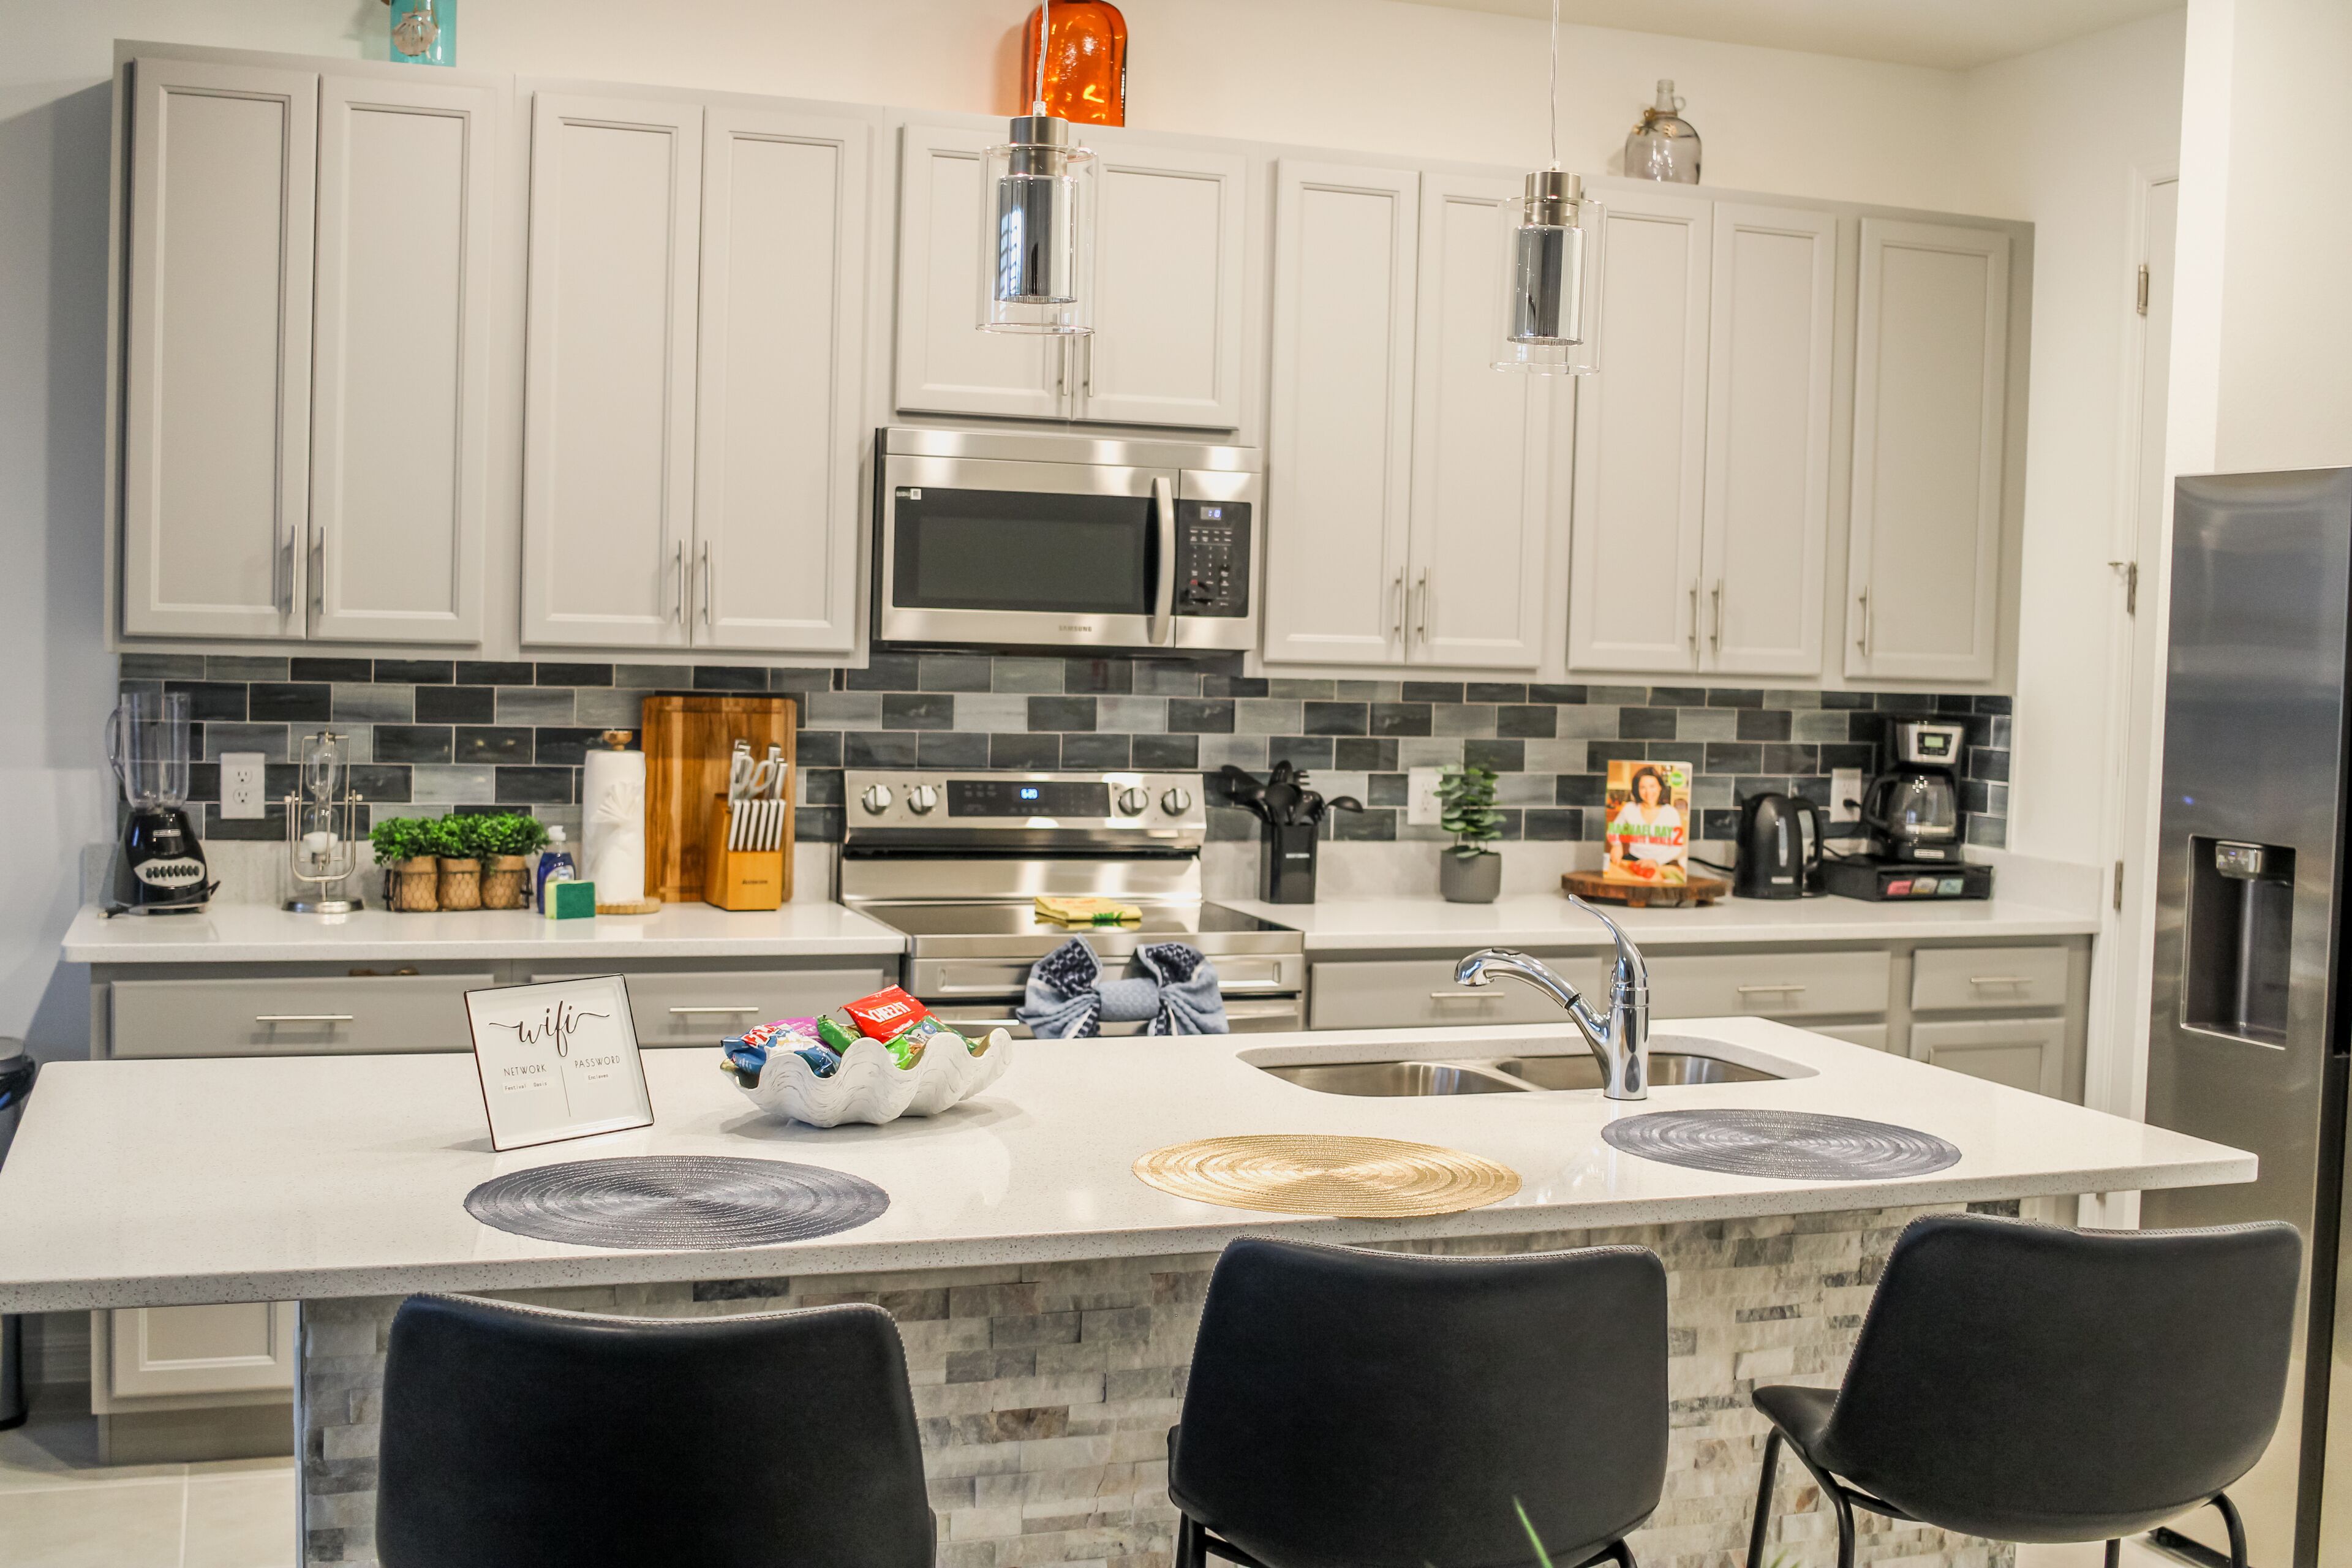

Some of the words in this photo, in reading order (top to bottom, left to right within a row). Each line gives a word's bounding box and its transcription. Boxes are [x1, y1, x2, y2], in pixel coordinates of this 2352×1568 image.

[1654, 825, 1672, 838] RAY
[1673, 826, 1684, 845] 2
[489, 1000, 610, 1057] wifi
[575, 1055, 620, 1069] PASSWORD
[503, 1063, 547, 1077] NETWORK
